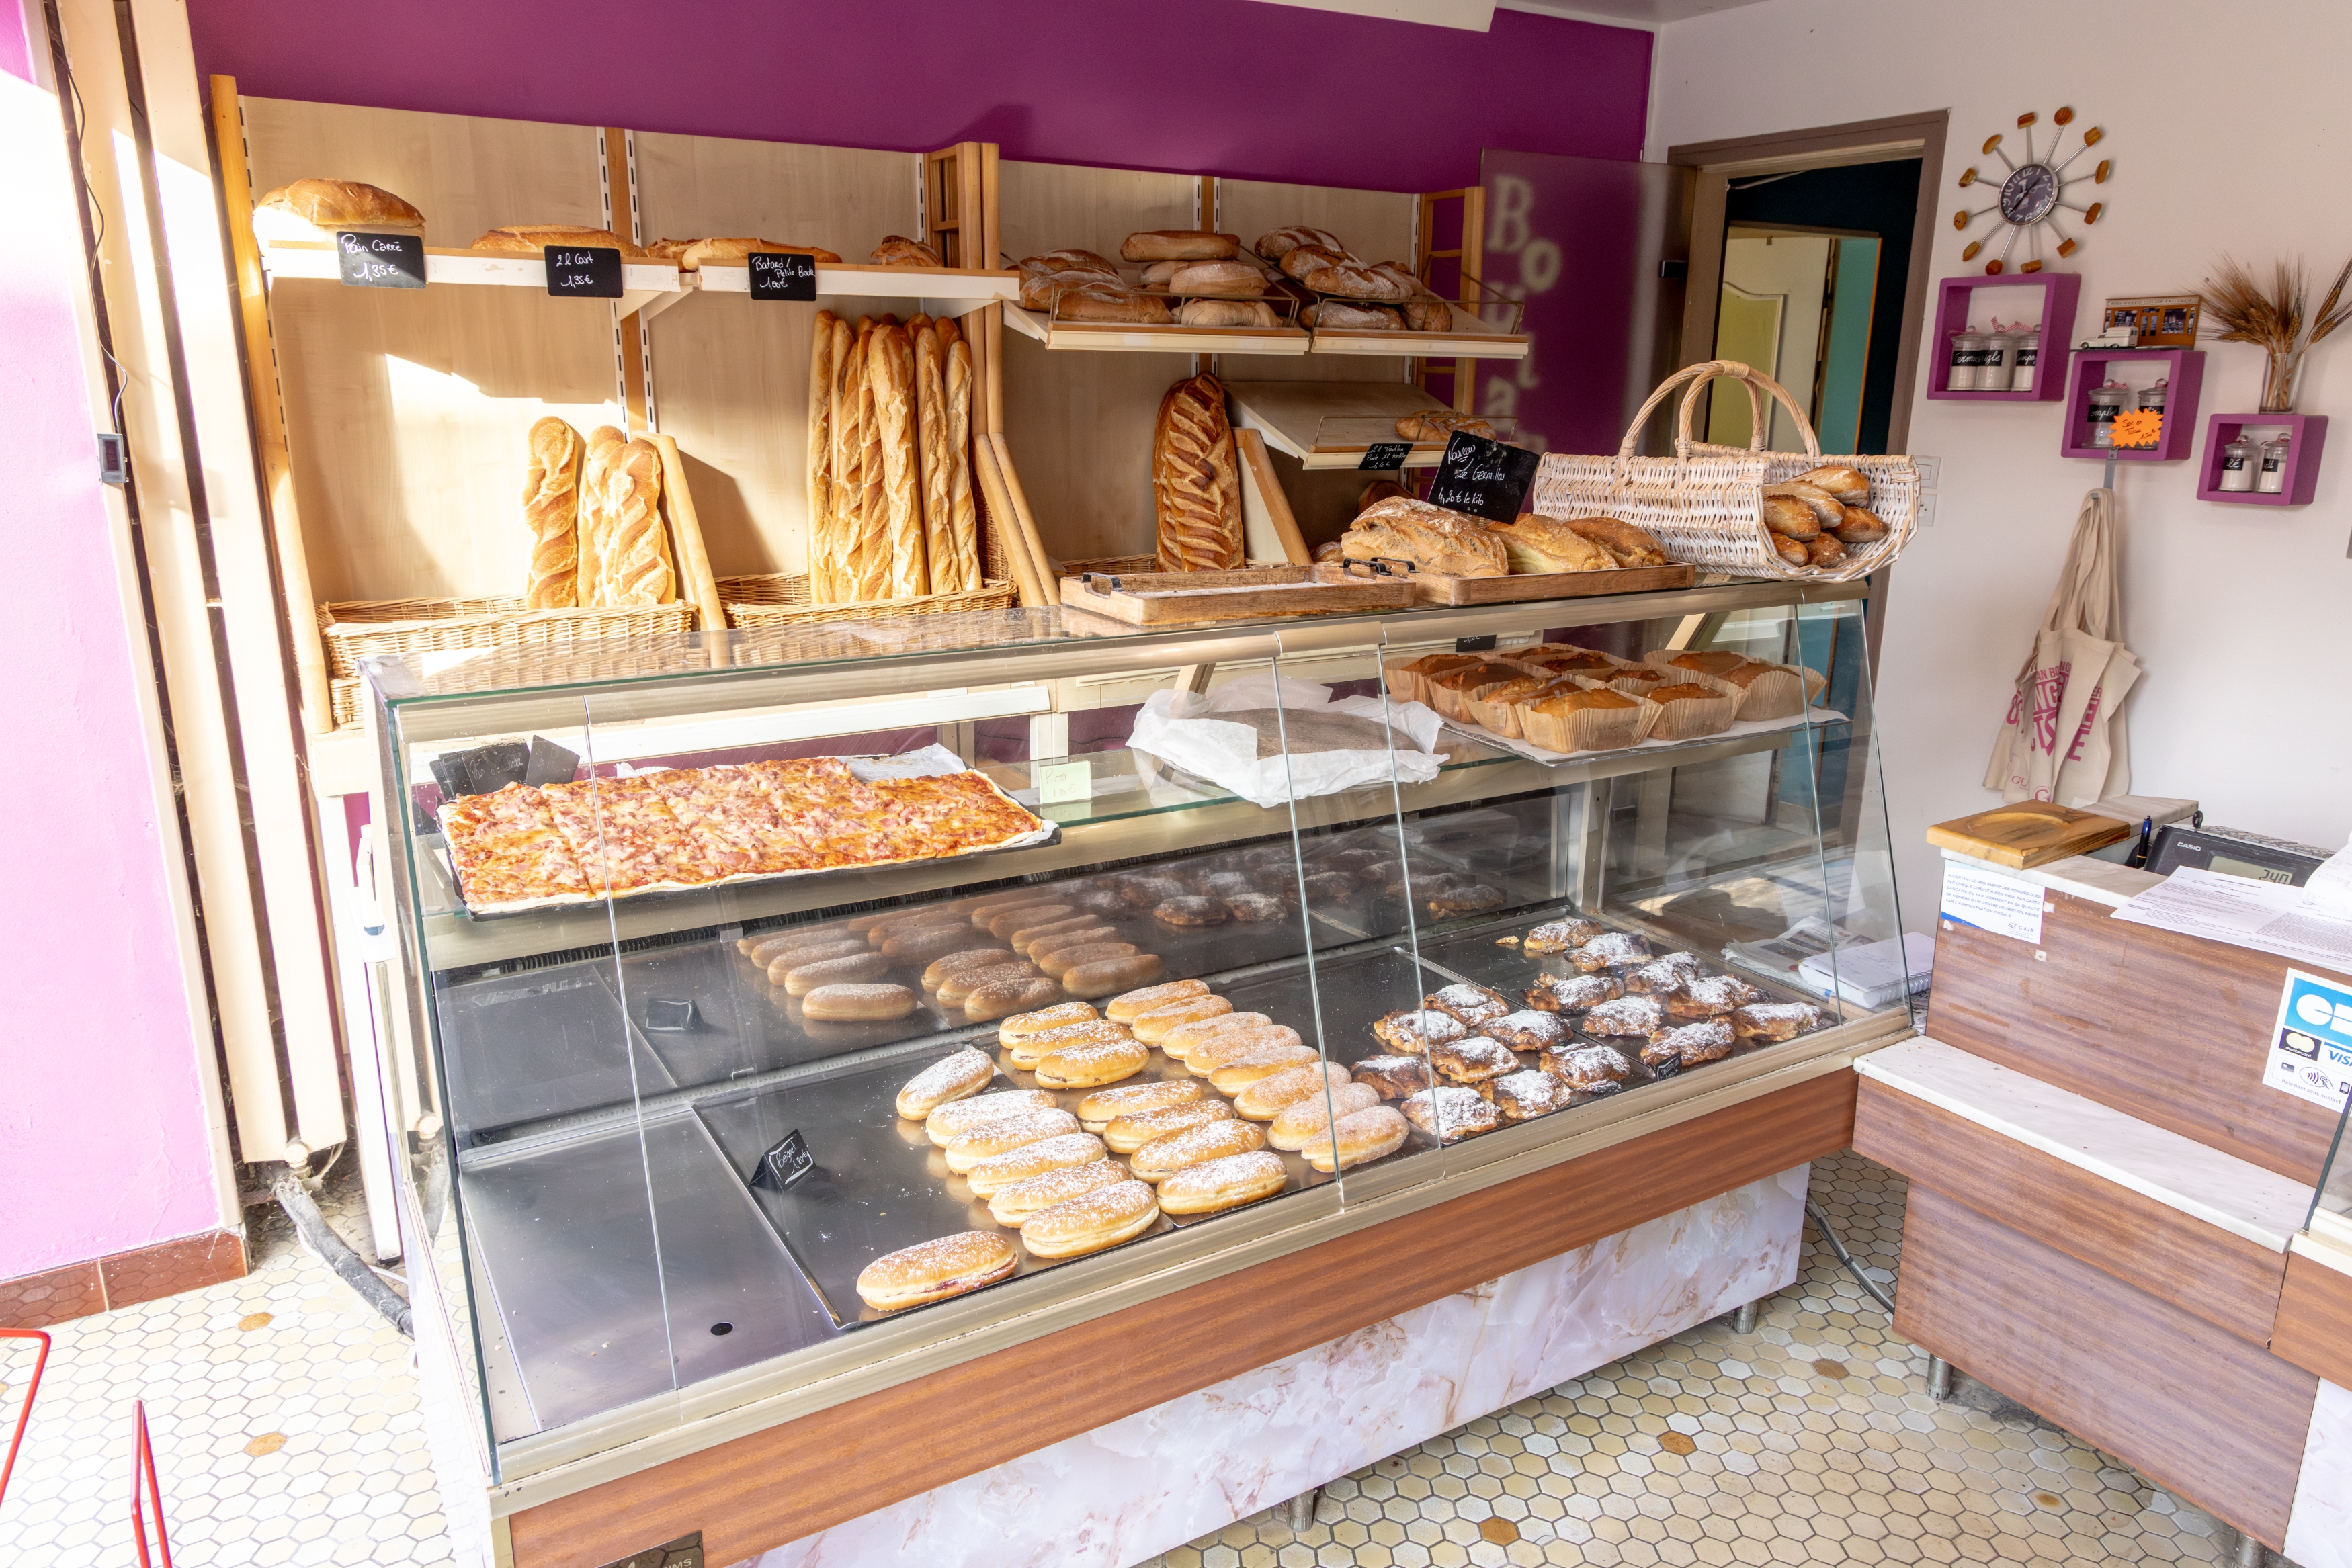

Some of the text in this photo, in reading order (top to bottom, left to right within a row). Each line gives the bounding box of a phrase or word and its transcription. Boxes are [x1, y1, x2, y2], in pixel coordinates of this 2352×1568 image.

[341, 234, 368, 253] Pain
[353, 262, 399, 282] 1,35€
[2177, 841, 2202, 851] CASIO
[2285, 1046, 2312, 1058] mastercard
[2281, 1078, 2341, 1104] Paiement sans contact
[775, 1140, 797, 1168] Beignet
